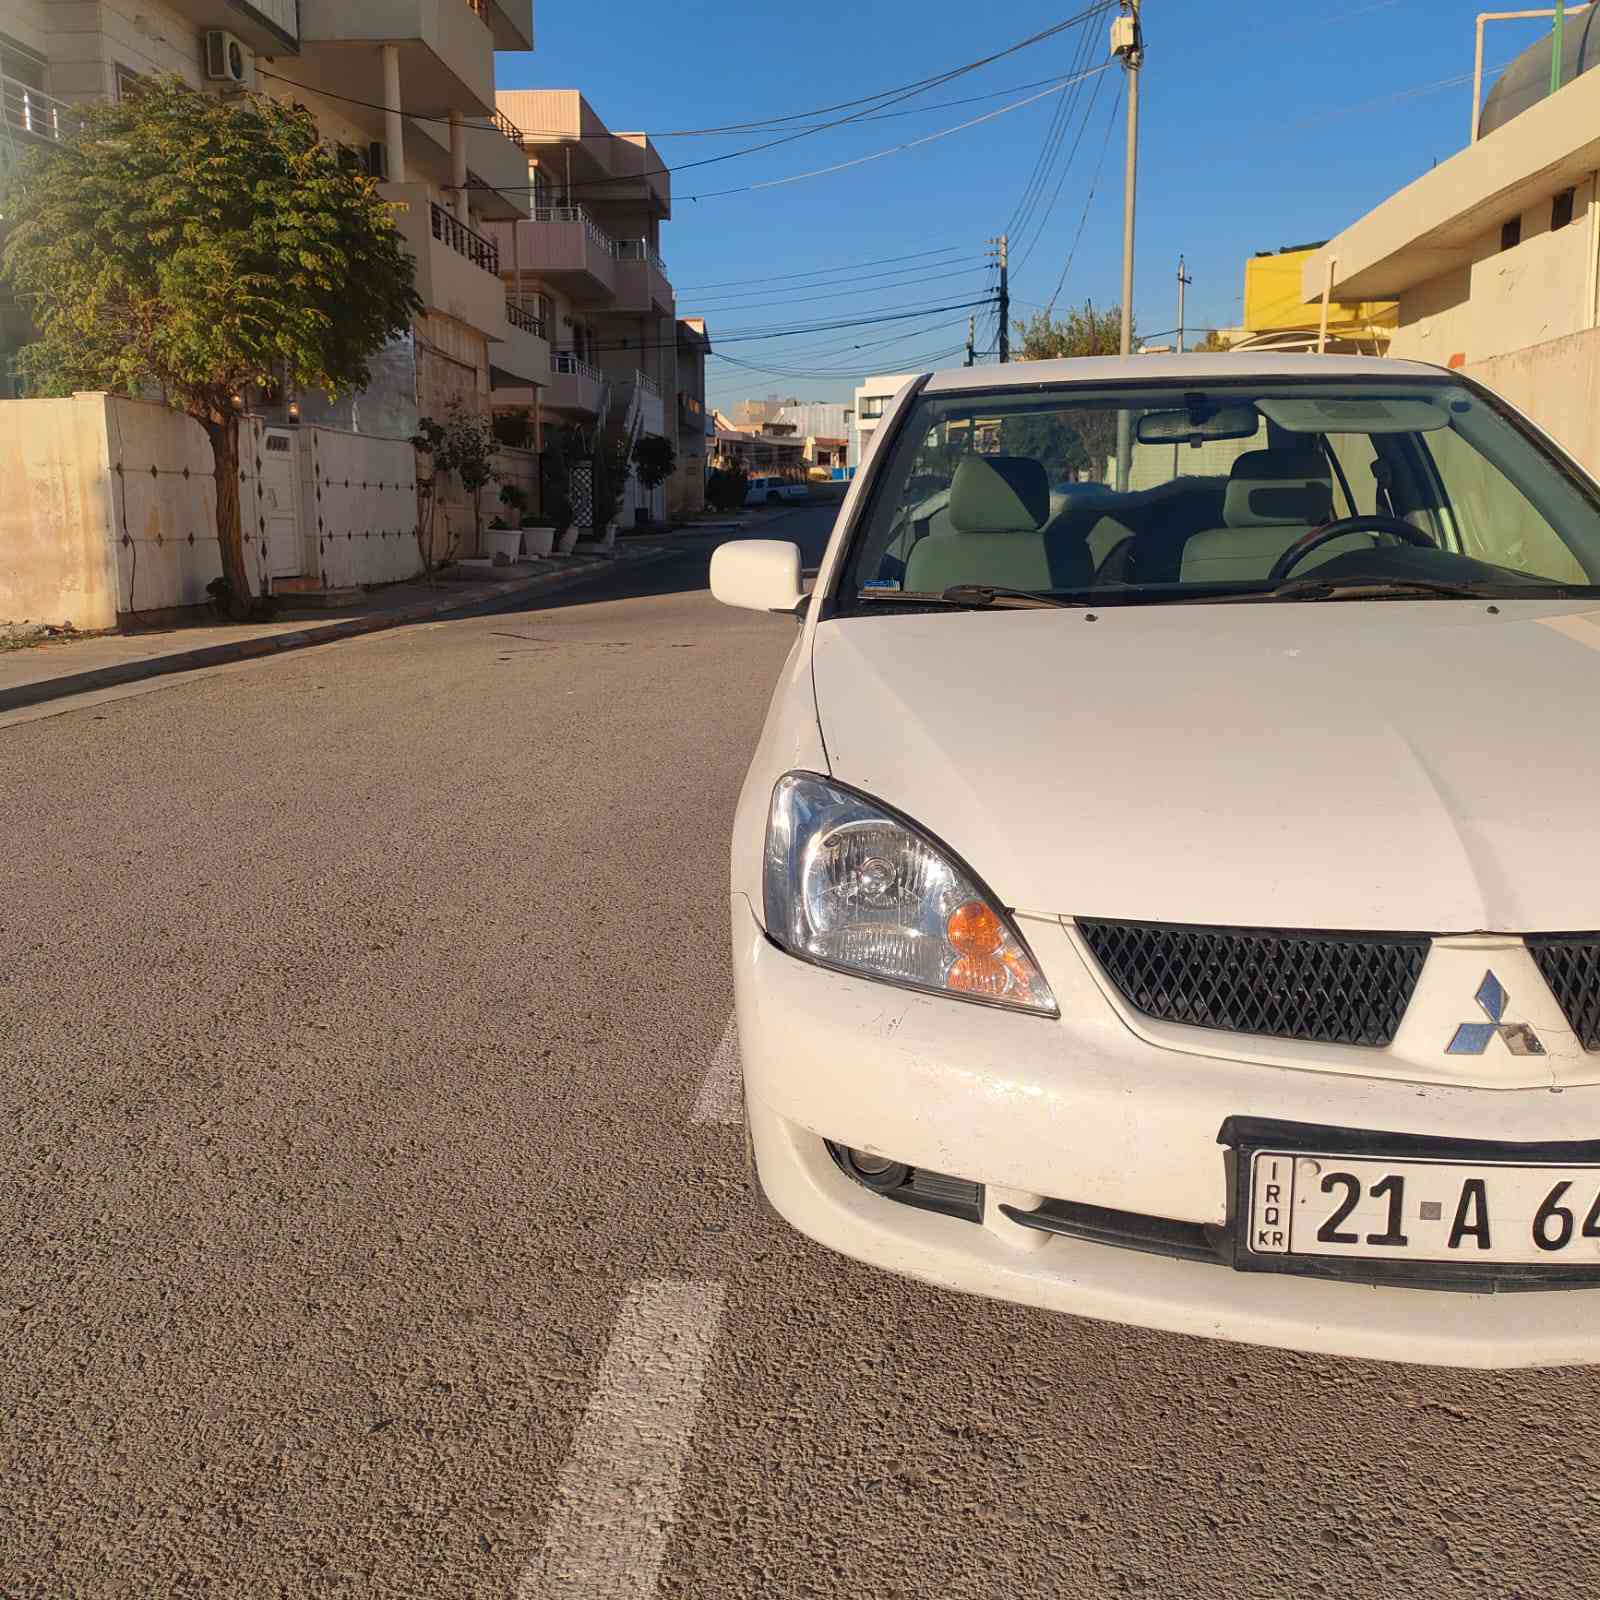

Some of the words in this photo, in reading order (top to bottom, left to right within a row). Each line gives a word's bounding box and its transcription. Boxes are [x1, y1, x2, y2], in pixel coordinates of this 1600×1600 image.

[1264, 1161, 1281, 1226] IRQ
[1316, 1172, 1409, 1247] 21
[1447, 1178, 1491, 1250] A
[1258, 1230, 1284, 1247] KR
